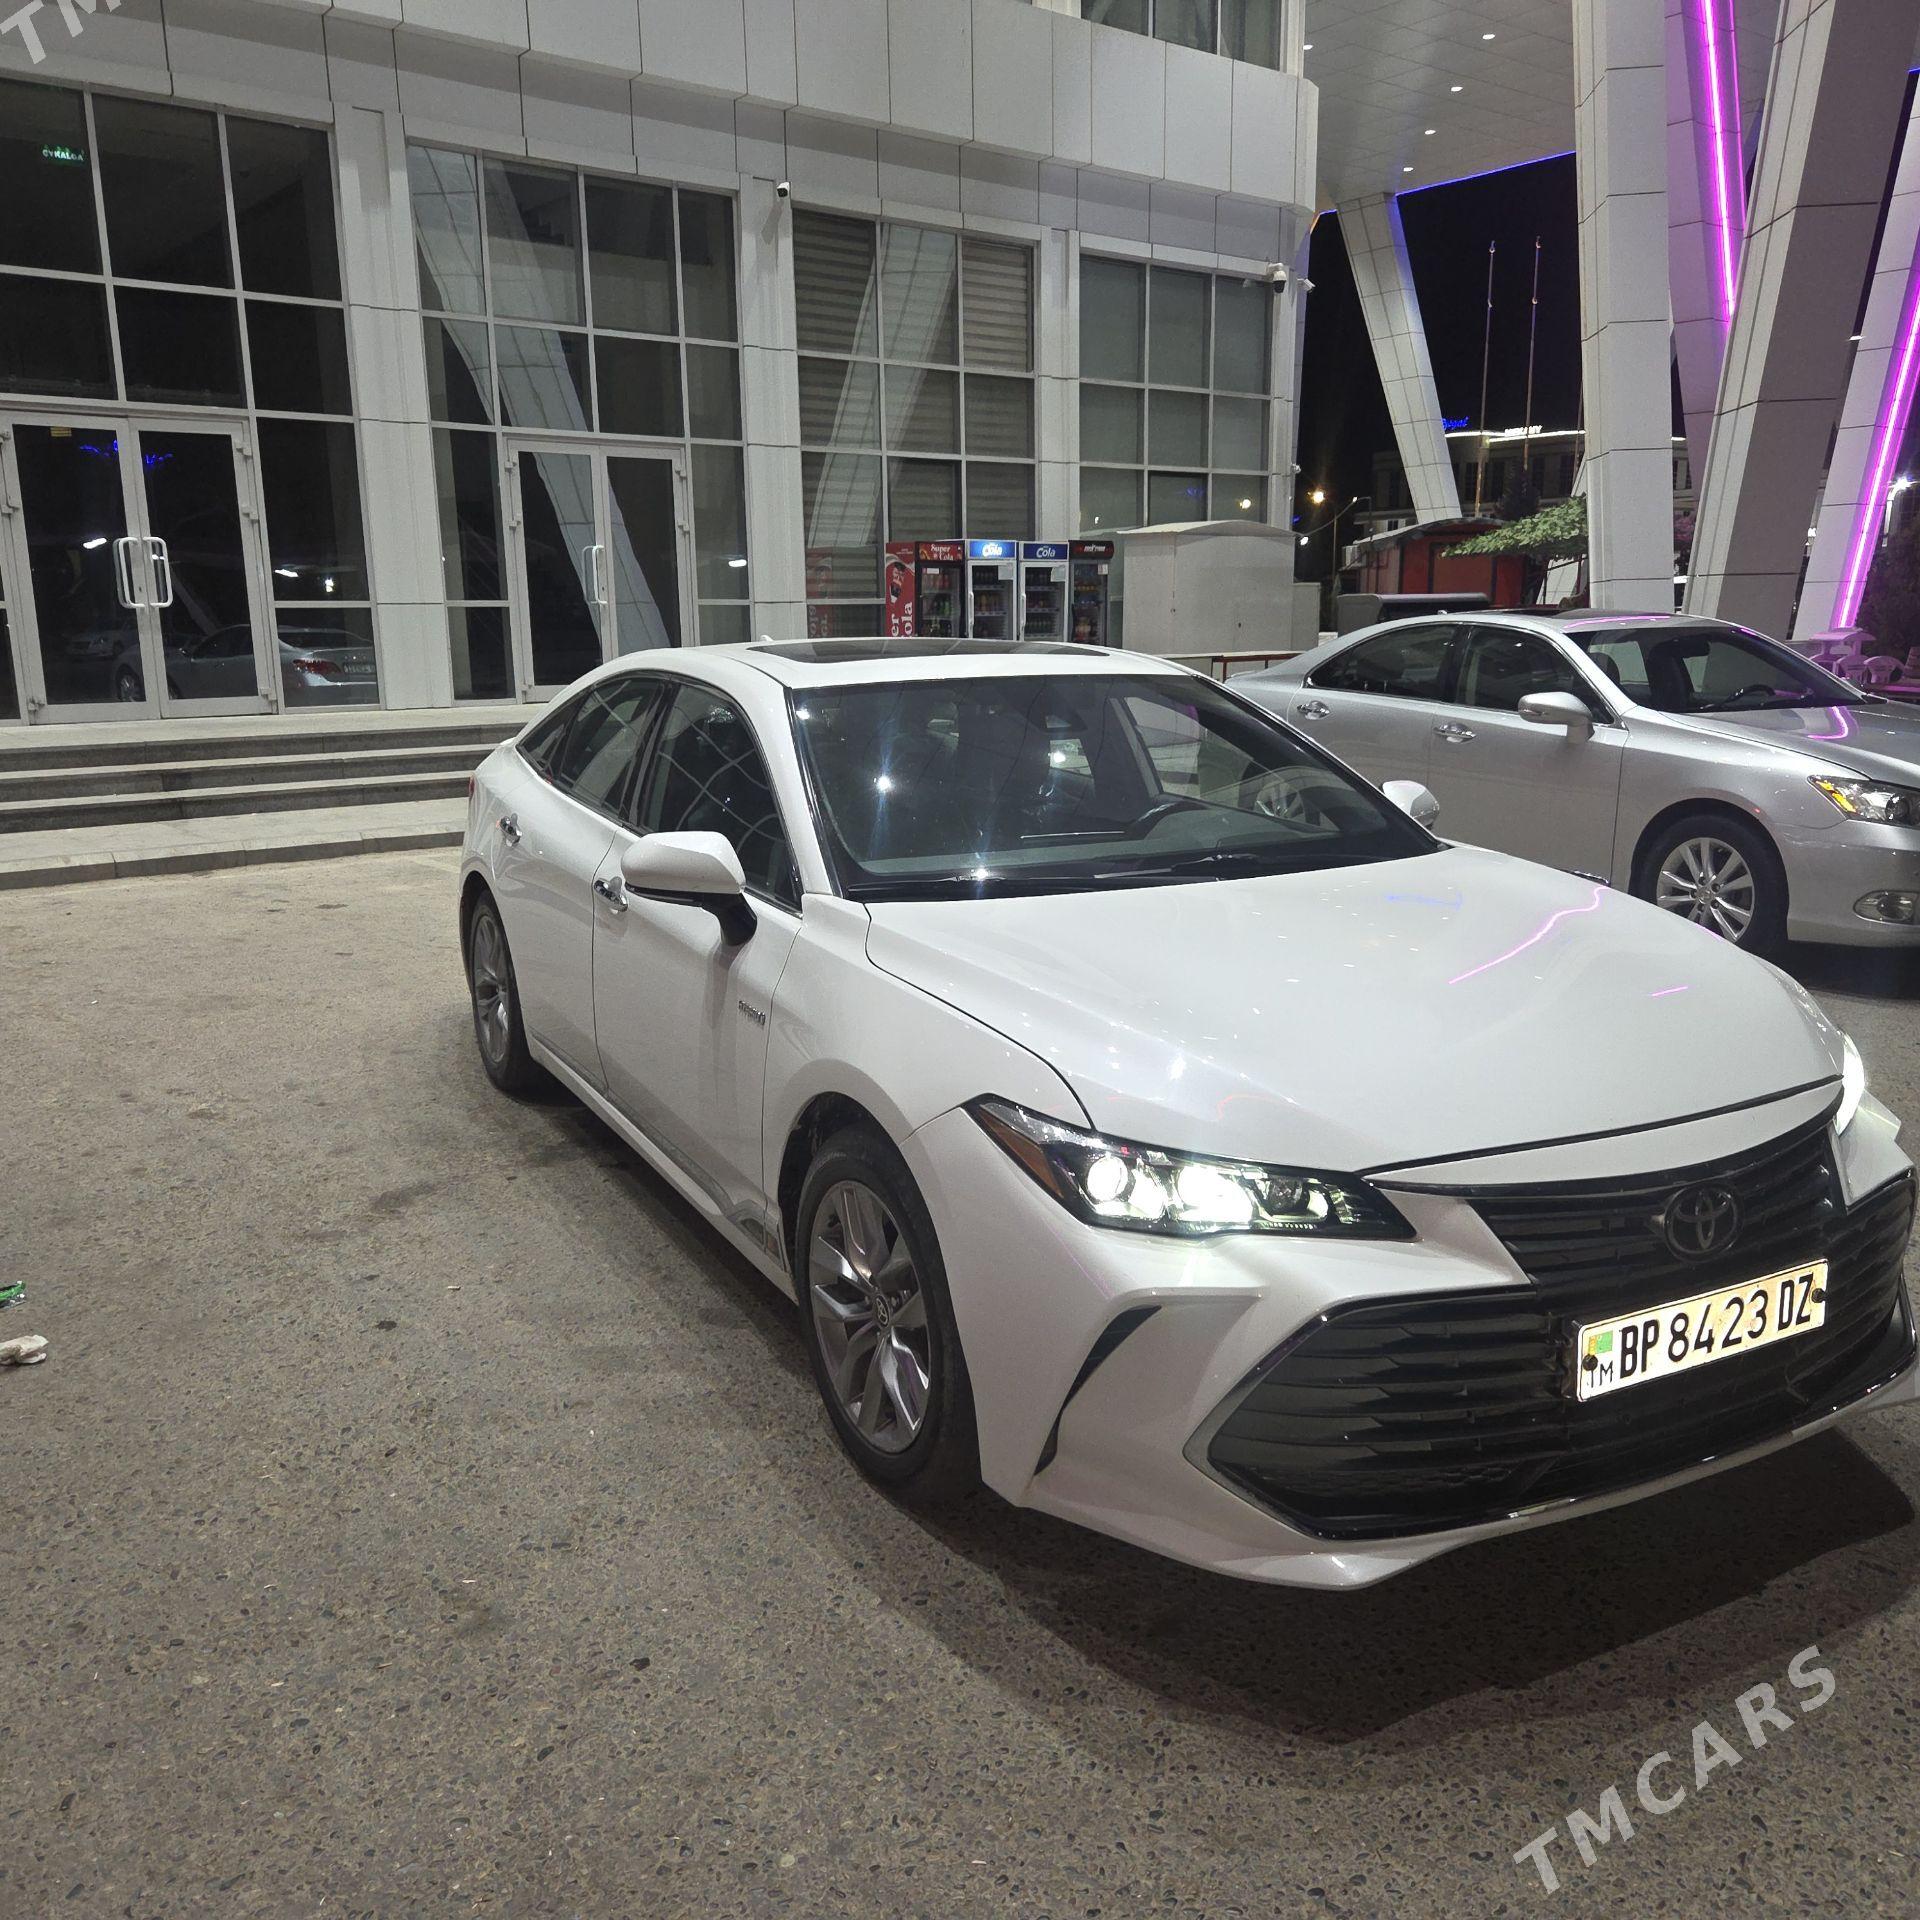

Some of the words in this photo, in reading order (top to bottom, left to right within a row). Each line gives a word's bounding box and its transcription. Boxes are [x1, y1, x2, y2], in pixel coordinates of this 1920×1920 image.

[930, 543, 951, 553] Super
[1036, 547, 1056, 558] Cola
[939, 552, 954, 561] Cola
[901, 602, 913, 638] ola
[1777, 1273, 1815, 1332] DZ
